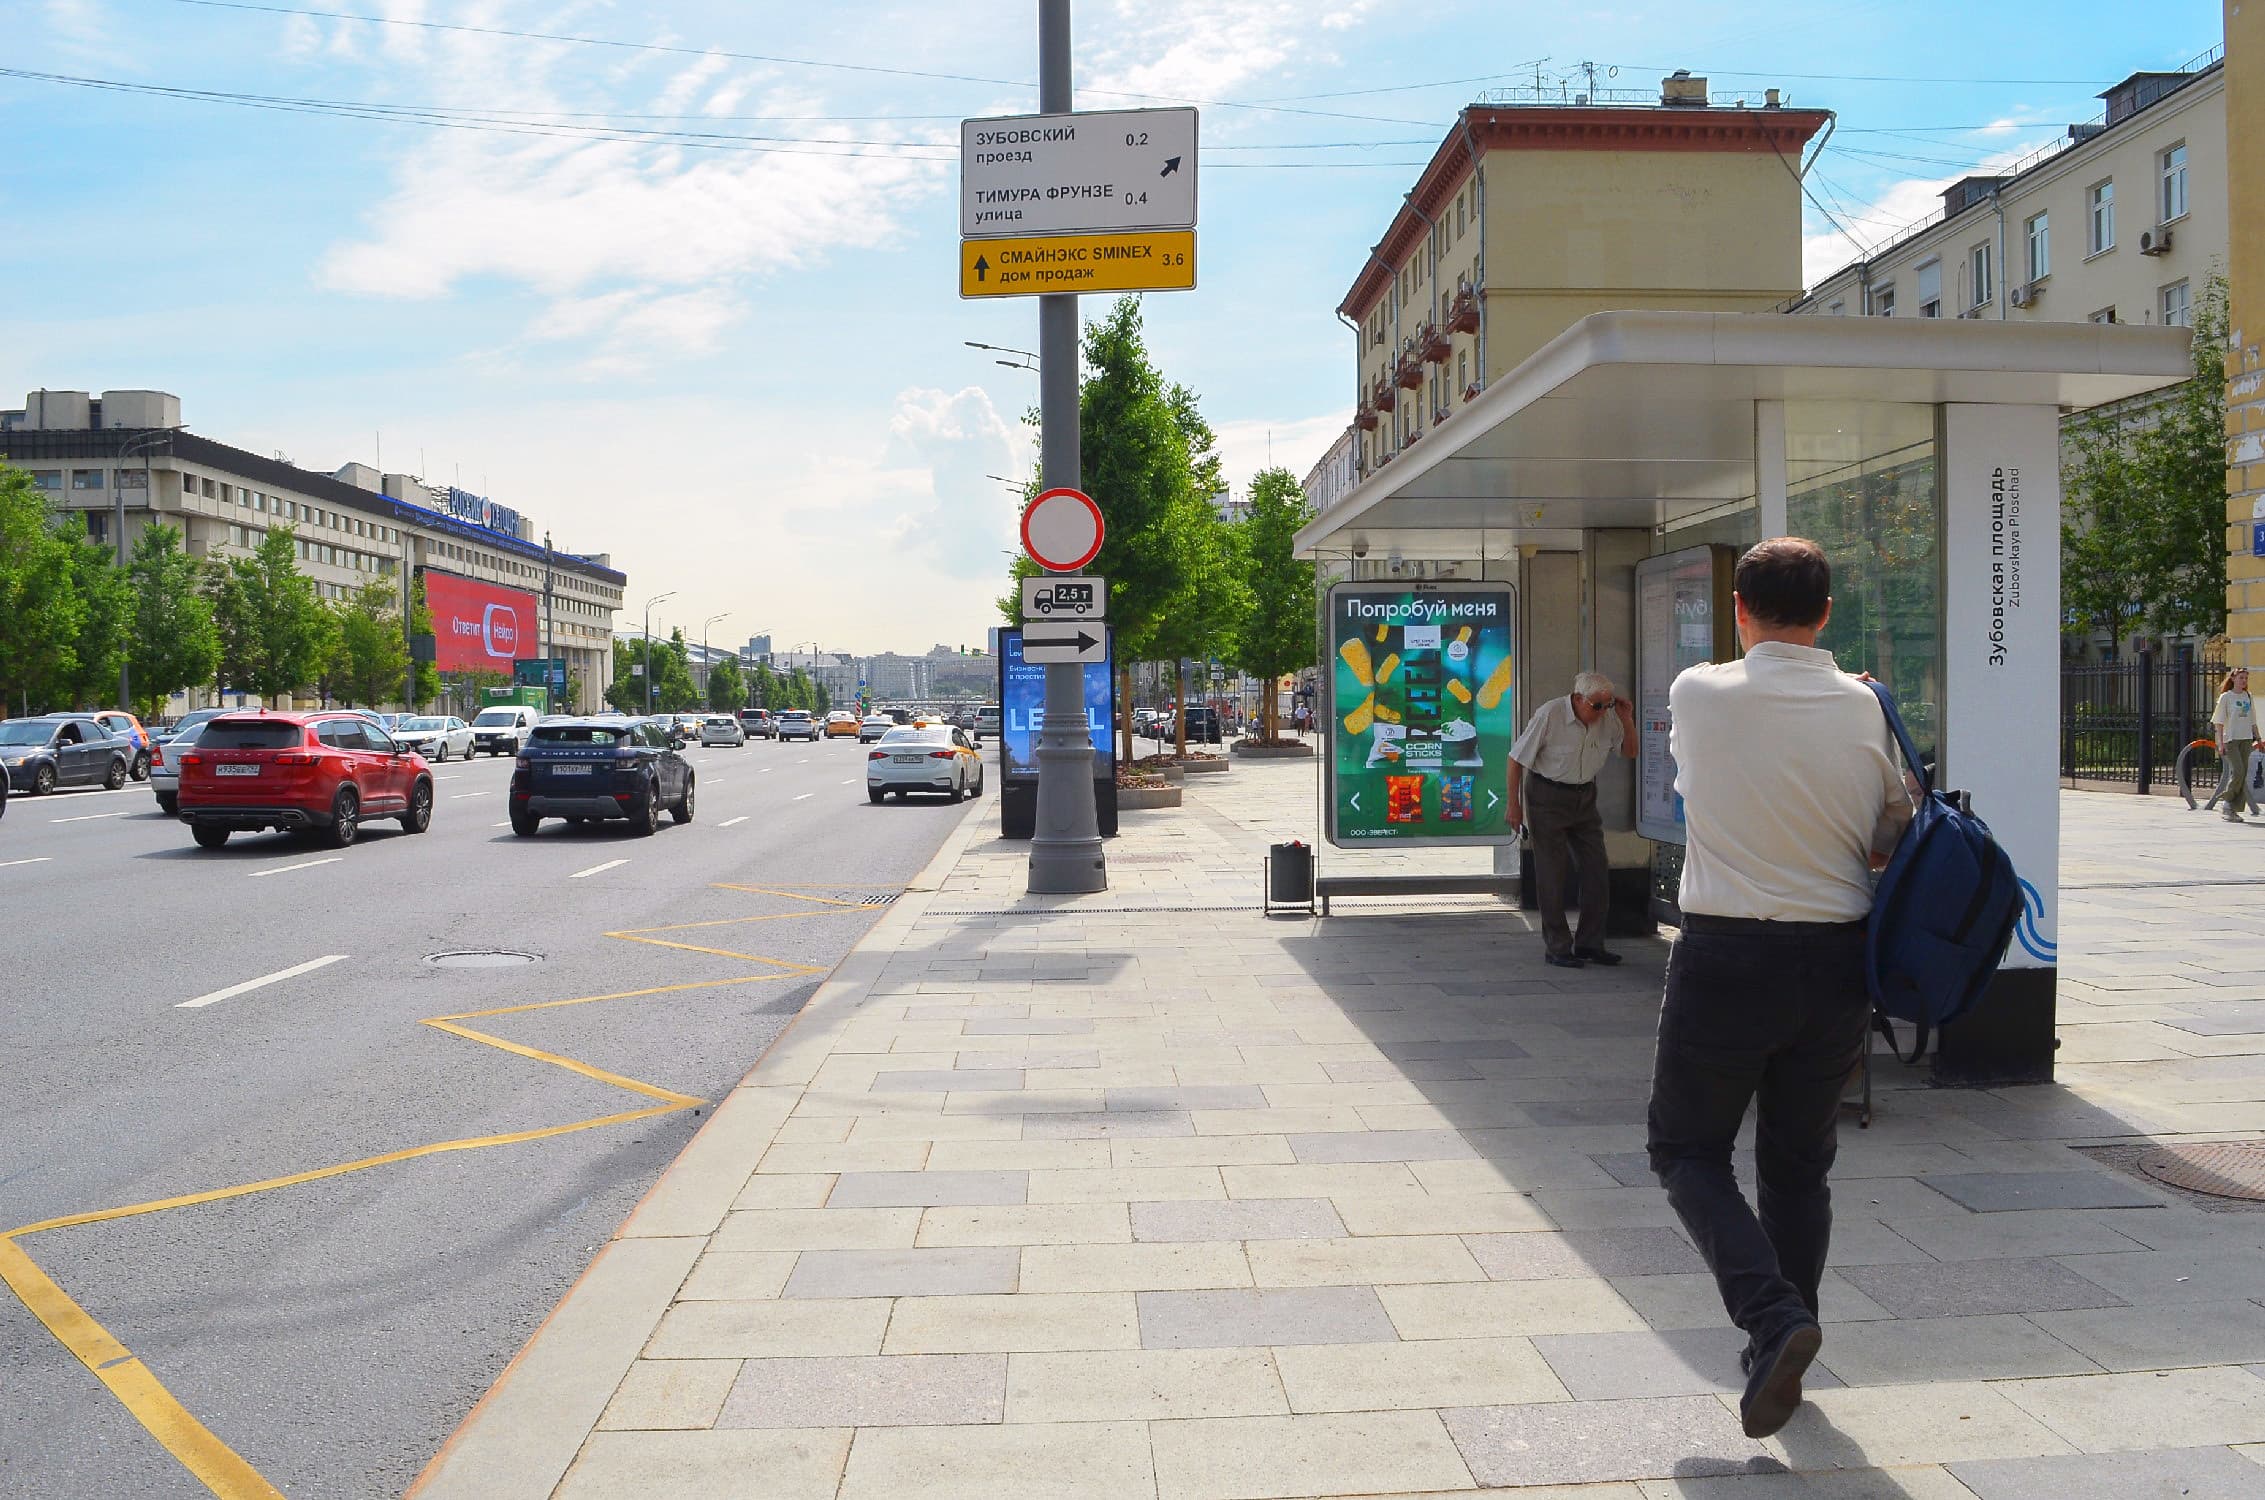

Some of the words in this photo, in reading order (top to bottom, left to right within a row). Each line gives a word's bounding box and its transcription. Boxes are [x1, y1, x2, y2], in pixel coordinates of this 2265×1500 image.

[975, 125, 1075, 145] ЗУБОВСКИЙ
[1125, 133, 1148, 146] 0.2
[976, 150, 1033, 165] проезд
[975, 188, 1041, 204] ТИМУРА
[1046, 184, 1113, 200] ФРУНЗЕ
[1125, 192, 1148, 205] 0.4
[975, 208, 1023, 224] улица
[1000, 247, 1088, 265] СМАЙНЭКС
[1092, 245, 1152, 260] SMINEX
[1162, 253, 1184, 266] 3.6
[1000, 271, 1030, 284] дом
[1036, 268, 1095, 284] продаж
[2008, 468, 2020, 527] Ploschad
[1992, 467, 2005, 556] площадь
[2009, 531, 2022, 608] Zubovskaya
[1058, 588, 1078, 600] 2,5
[1347, 599, 1447, 622] Попробуй
[1451, 603, 1497, 616] меня
[1989, 562, 2007, 666] Зубовская
[452, 616, 481, 636] Ответит
[493, 621, 513, 644] Нейро
[1010, 707, 1104, 731] LEL
[1405, 742, 1442, 750] CORN
[1405, 750, 1442, 758] STICKS
[1350, 829, 1367, 837] ООО
